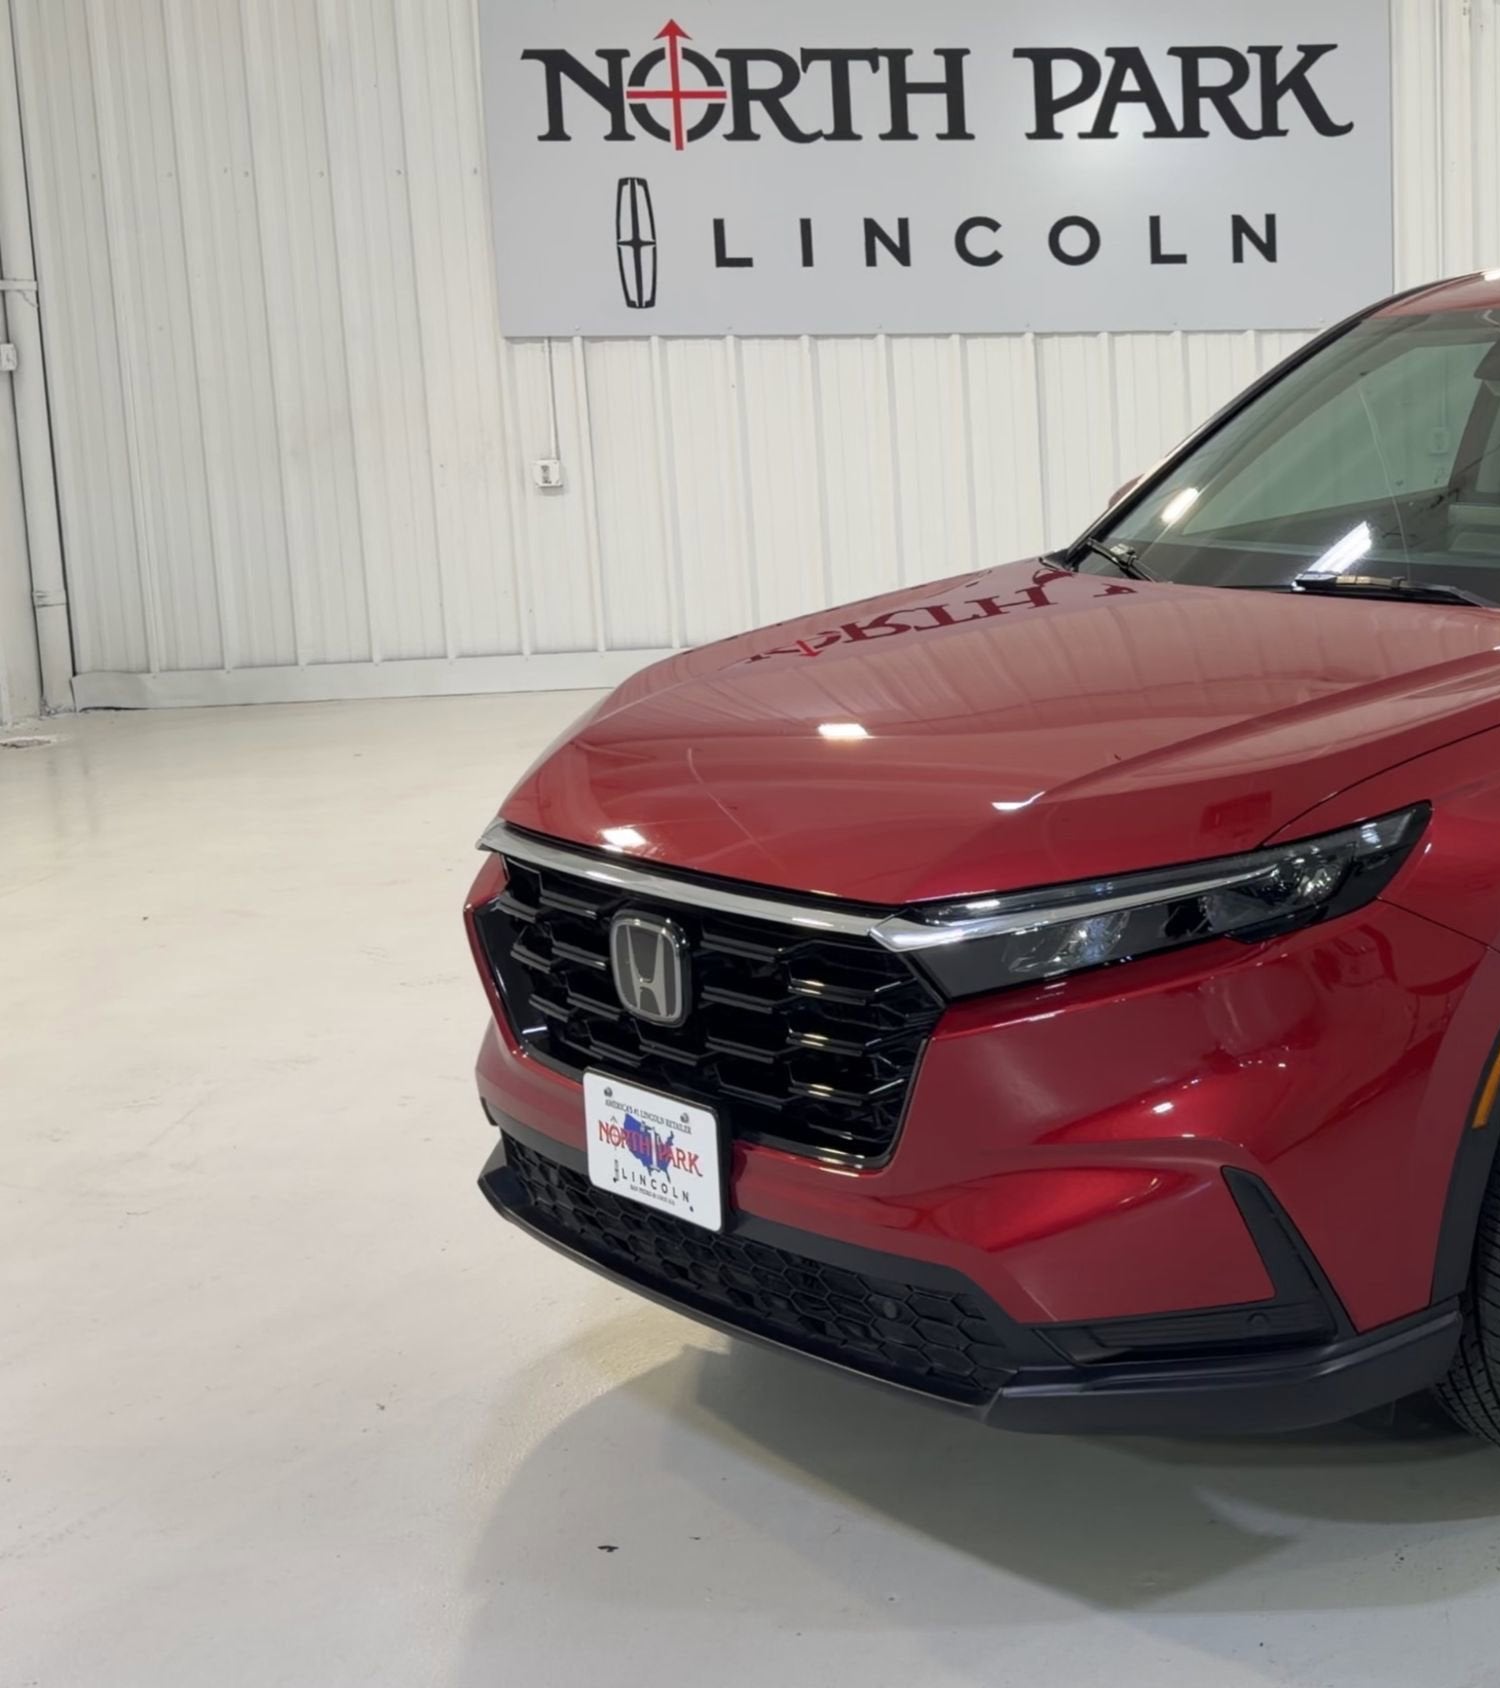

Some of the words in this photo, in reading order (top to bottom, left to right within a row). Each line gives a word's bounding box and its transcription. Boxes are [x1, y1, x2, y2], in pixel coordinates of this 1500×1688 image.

[520, 46, 976, 144] NORTH
[1012, 43, 1354, 141] PARK
[713, 213, 1278, 268] LINCOLN
[640, 1108, 665, 1125] LINCOLN
[599, 1120, 651, 1156] NORTH
[657, 1138, 703, 1177] PARK
[622, 1168, 689, 1202] LINCOLN
